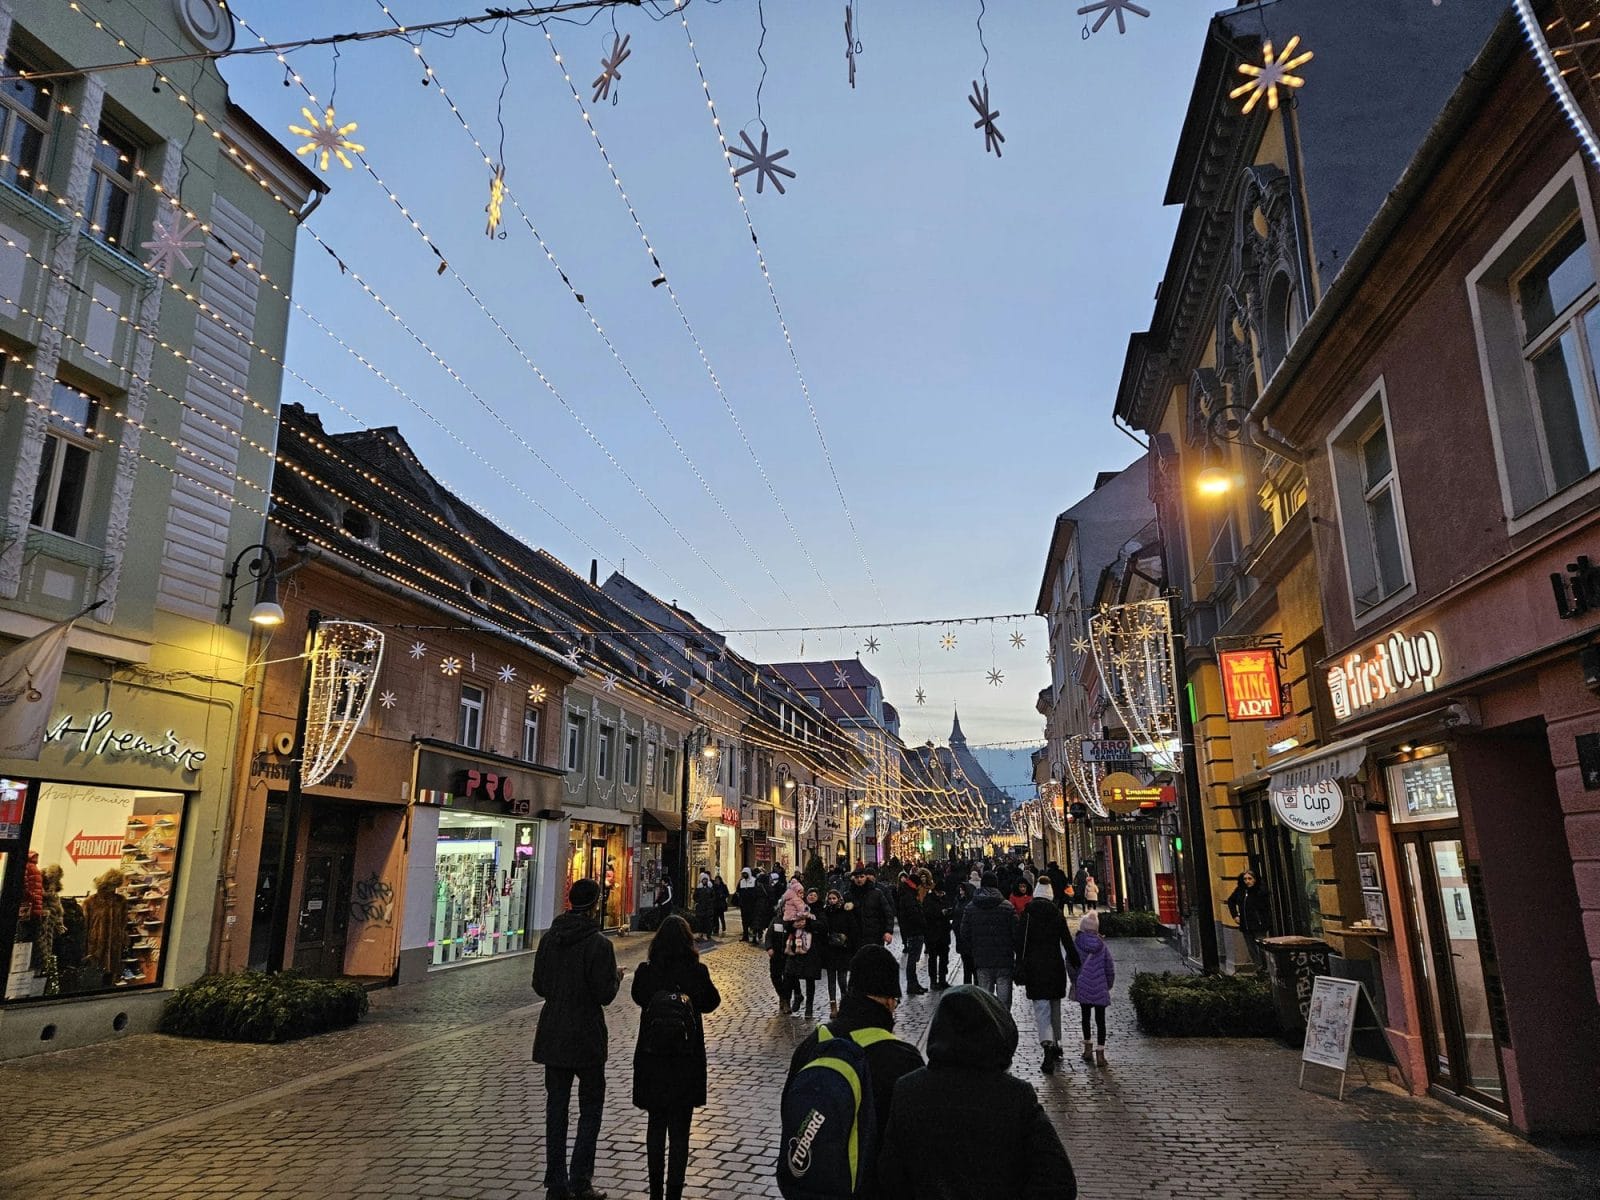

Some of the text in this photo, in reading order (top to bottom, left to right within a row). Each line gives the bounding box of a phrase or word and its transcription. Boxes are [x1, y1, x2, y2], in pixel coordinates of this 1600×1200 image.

[1388, 630, 1442, 692] Cup
[1232, 672, 1271, 700] KING
[1237, 700, 1272, 716] ART
[466, 769, 514, 802] PRO
[1303, 794, 1331, 813] Cup
[1288, 814, 1309, 827] Coffee
[792, 1111, 826, 1167] TUBORG
